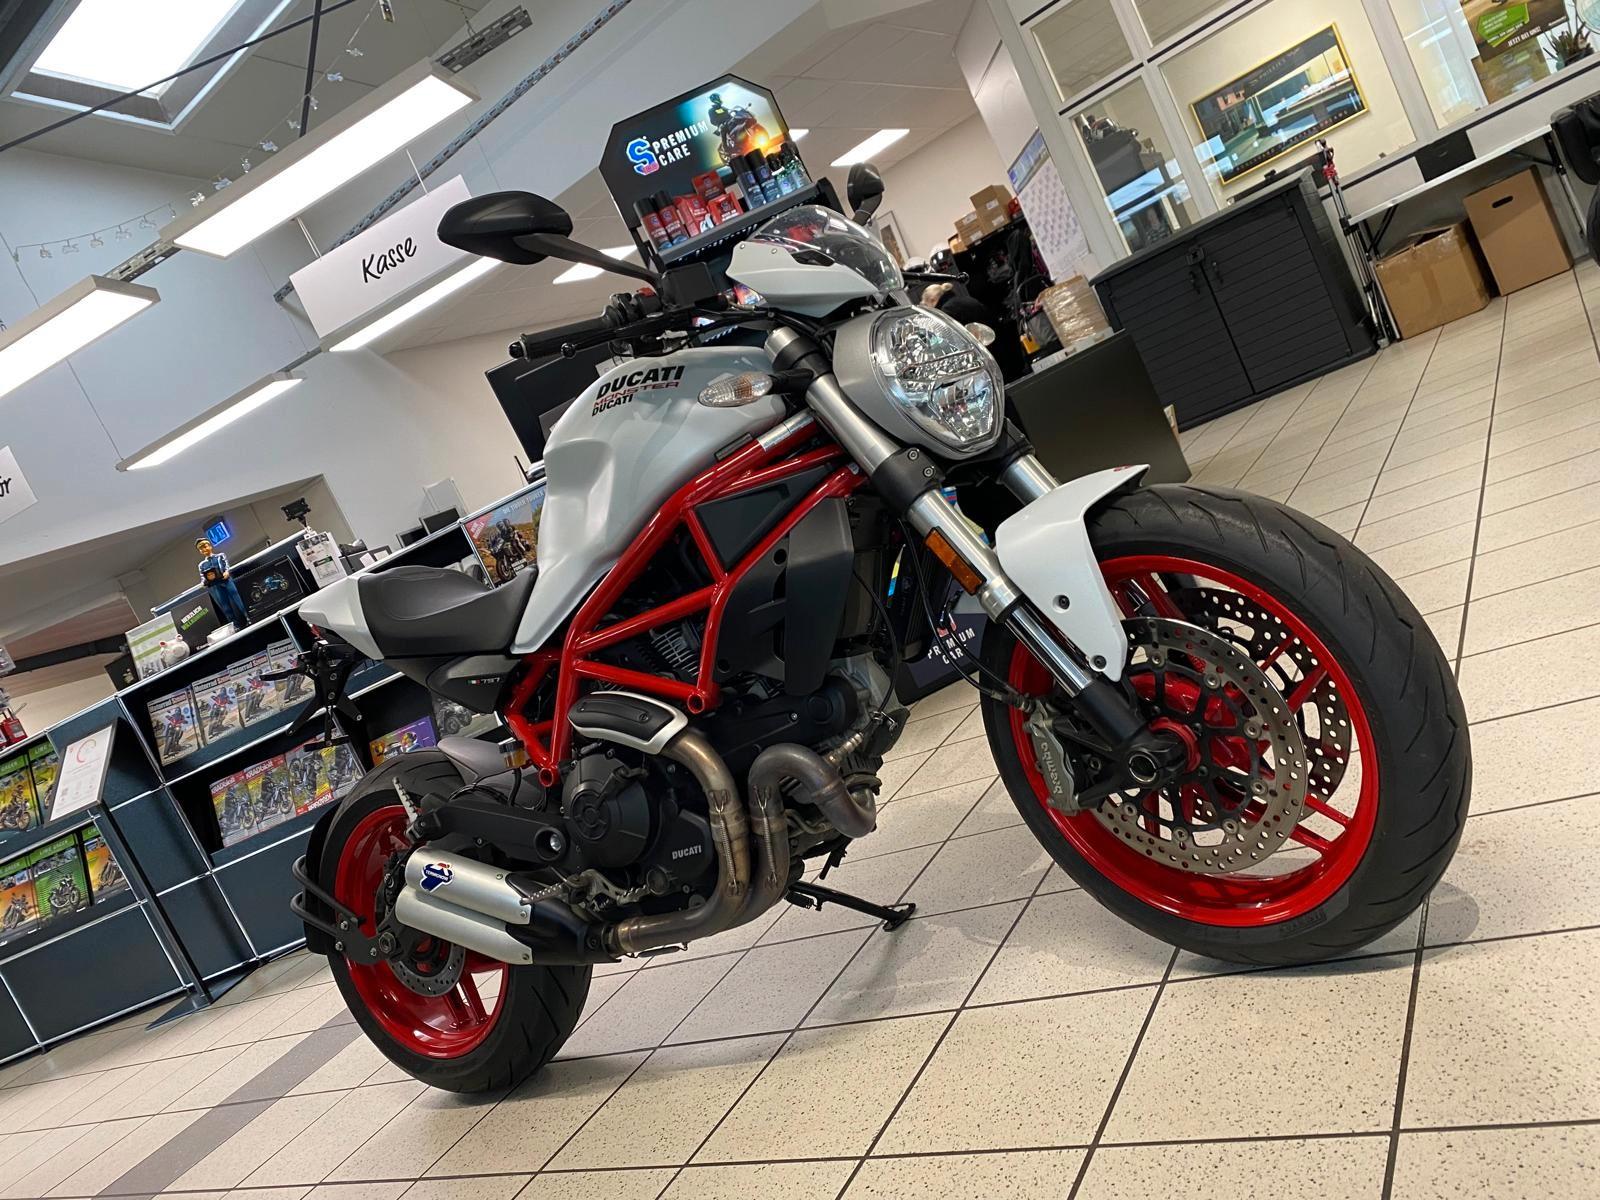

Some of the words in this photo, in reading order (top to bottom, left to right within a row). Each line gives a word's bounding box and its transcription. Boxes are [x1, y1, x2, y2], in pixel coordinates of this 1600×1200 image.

[652, 120, 708, 154] PREMIUM
[658, 143, 691, 167] CARE
[362, 237, 417, 283] Kasse
[594, 381, 680, 407] MONSTER
[596, 365, 685, 400] DUCATI
[591, 394, 634, 417] DUCATI
[927, 627, 976, 660] PRMUM
[671, 844, 702, 860] DUCATI
